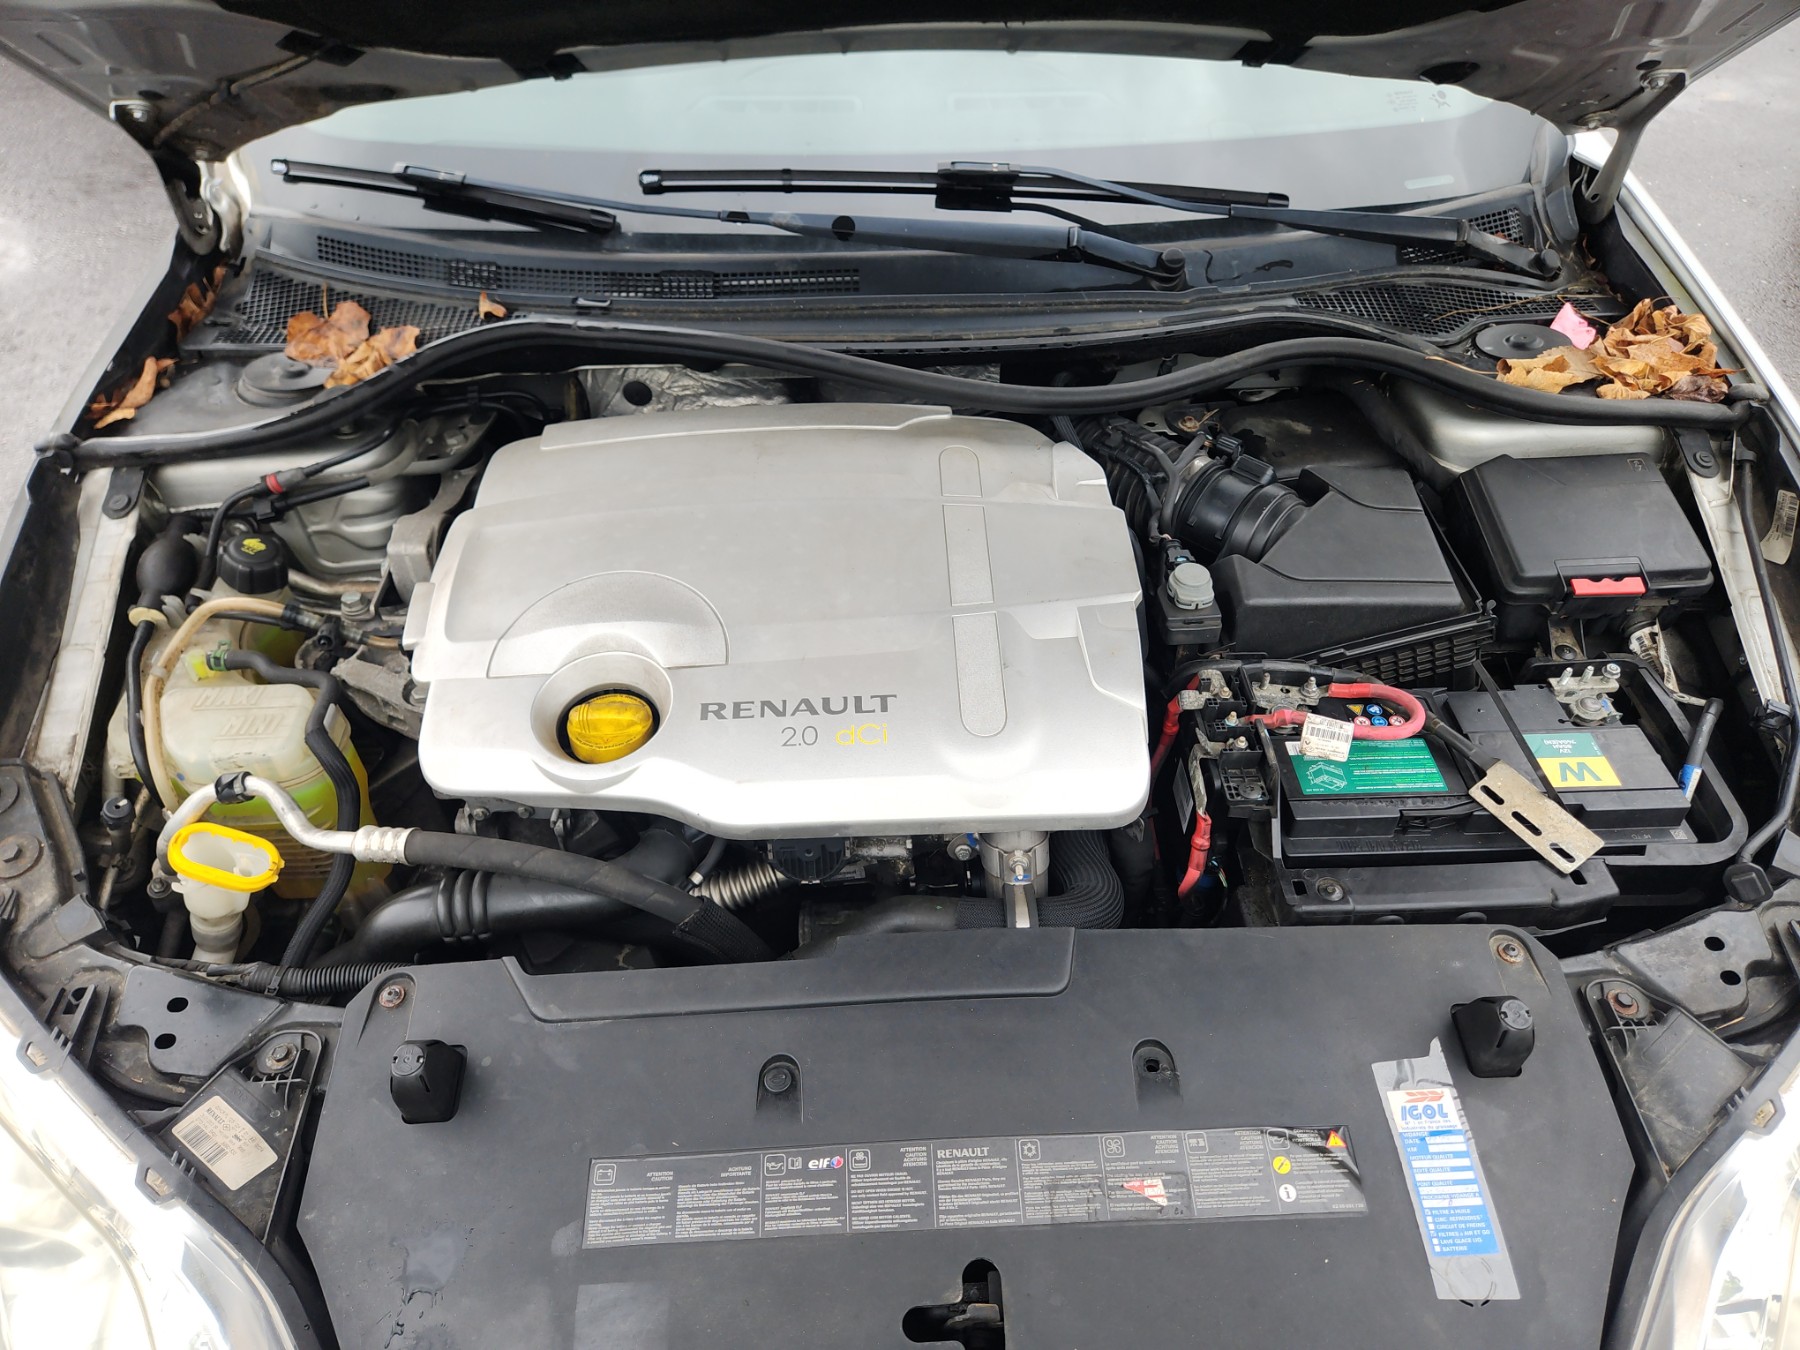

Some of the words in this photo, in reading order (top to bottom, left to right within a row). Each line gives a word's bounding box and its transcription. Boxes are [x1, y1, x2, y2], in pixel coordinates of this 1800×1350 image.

[699, 694, 898, 721] RENAULT
[780, 725, 818, 747] 2.0
[835, 723, 888, 746] dCi
[1401, 1103, 1448, 1121] IGOL
[937, 1147, 989, 1159] RENAULT
[808, 1157, 832, 1169] elf
